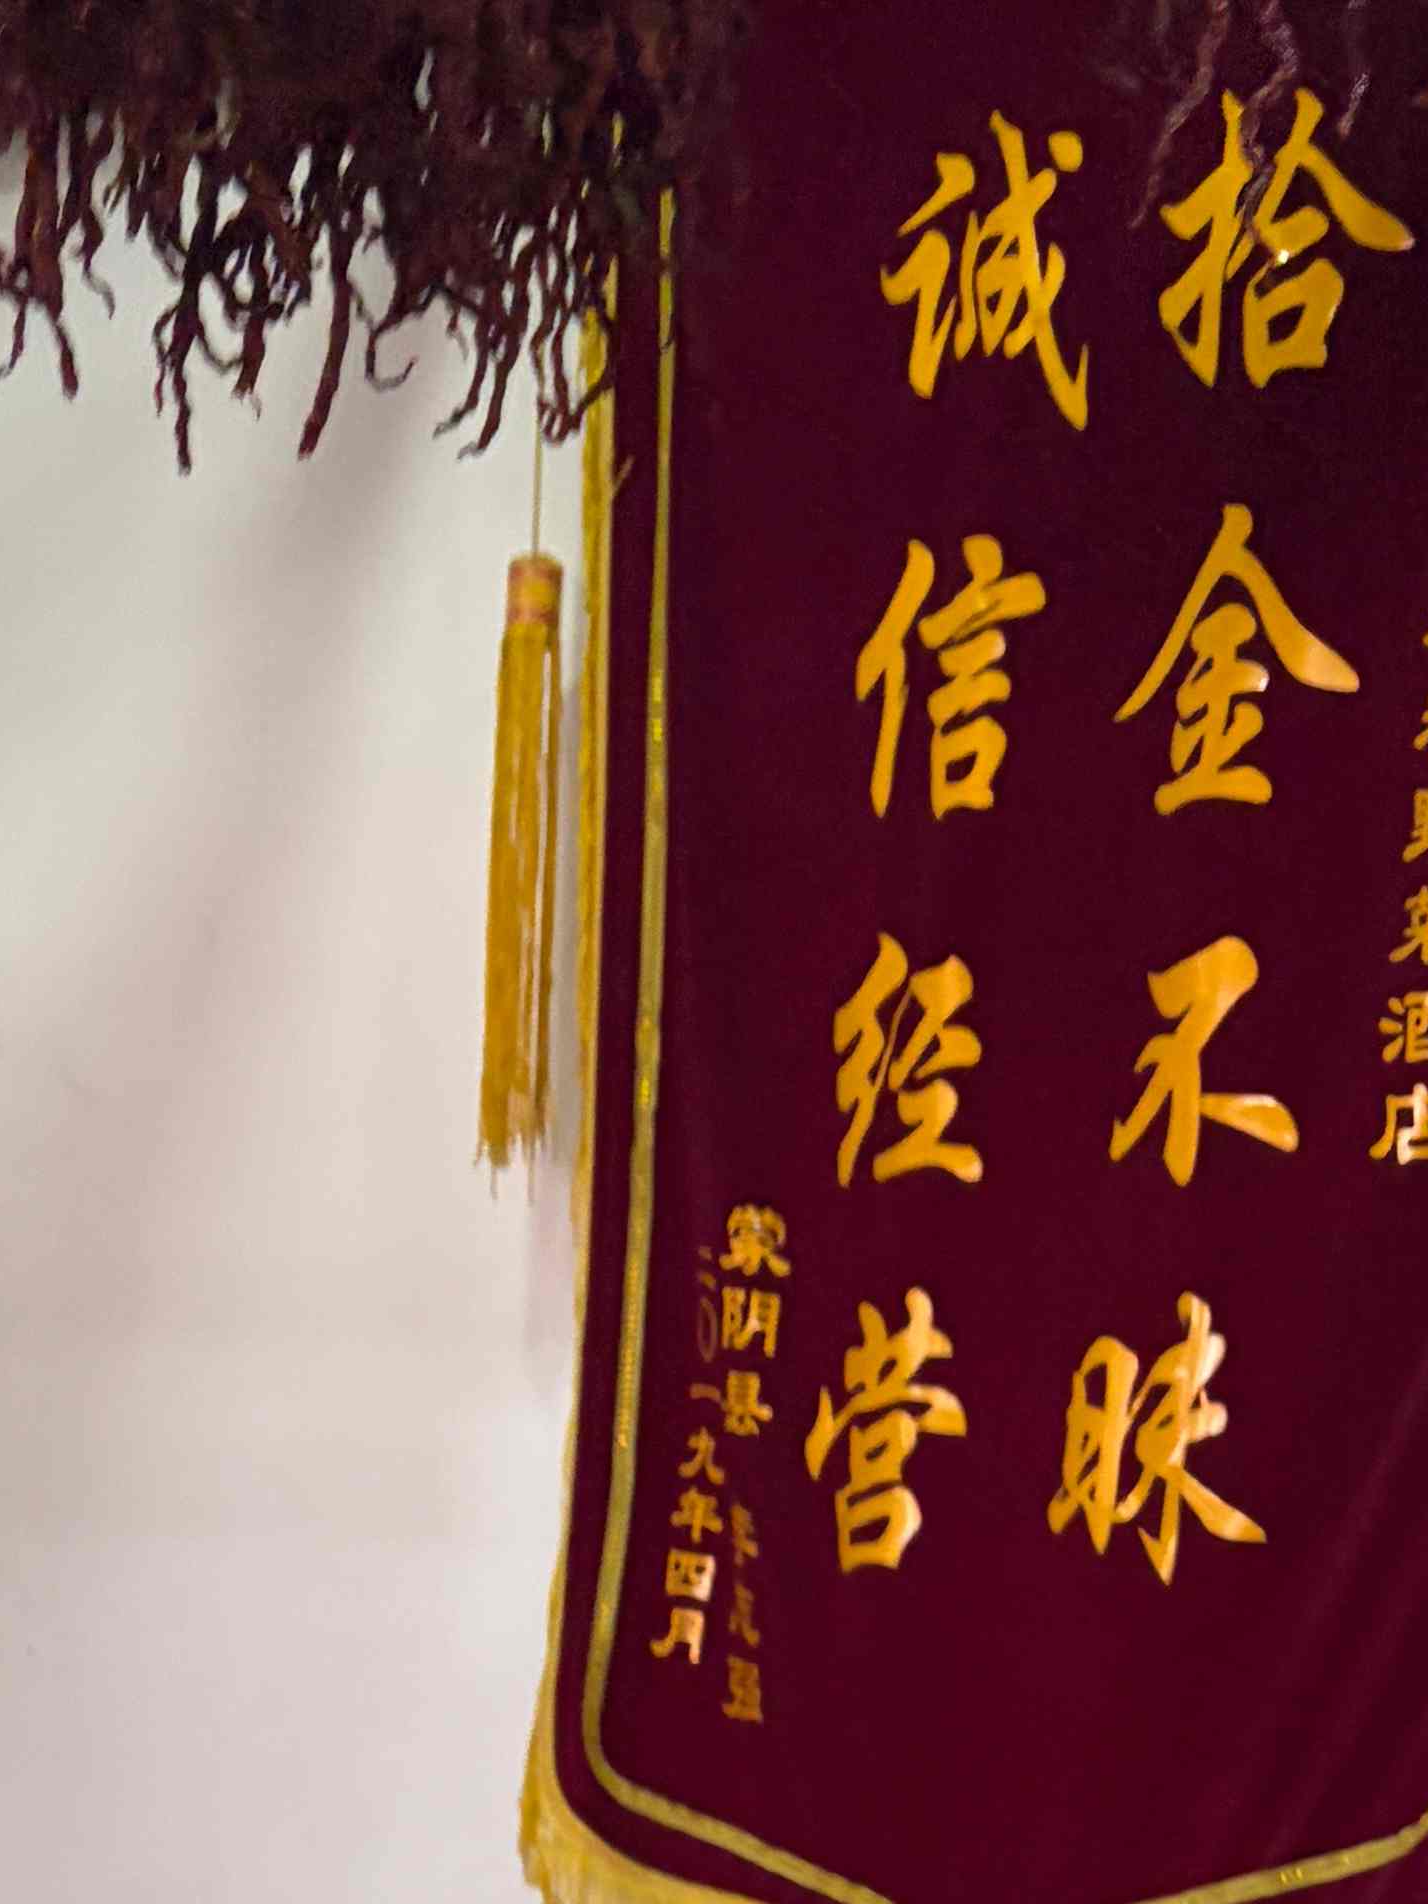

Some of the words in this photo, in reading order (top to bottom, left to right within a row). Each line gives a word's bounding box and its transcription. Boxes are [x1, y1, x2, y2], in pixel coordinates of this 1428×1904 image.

[803, 108, 1090, 1573] 诚信经营
[1047, 87, 1415, 1586] 拾金不昧
